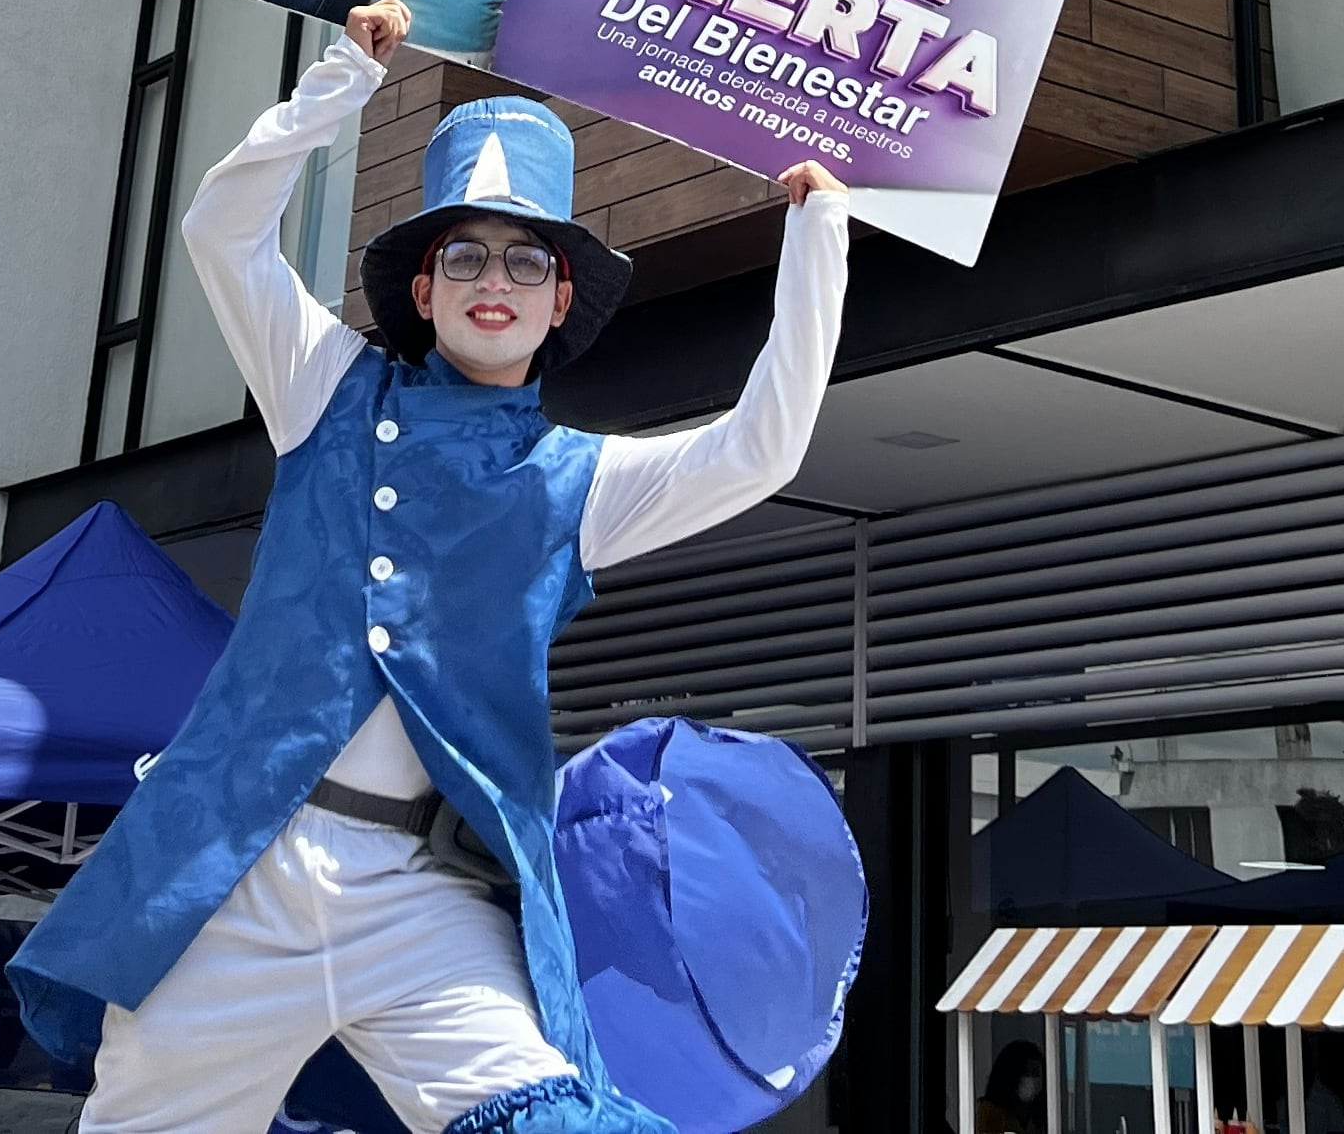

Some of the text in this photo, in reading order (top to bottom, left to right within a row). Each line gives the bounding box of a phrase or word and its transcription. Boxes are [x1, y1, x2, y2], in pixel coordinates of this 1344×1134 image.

[597, 22, 914, 160] Una jornada dedicada a nuestros
[637, 63, 855, 165] adultos mayores.
[692, 13, 930, 136] Bienestar
